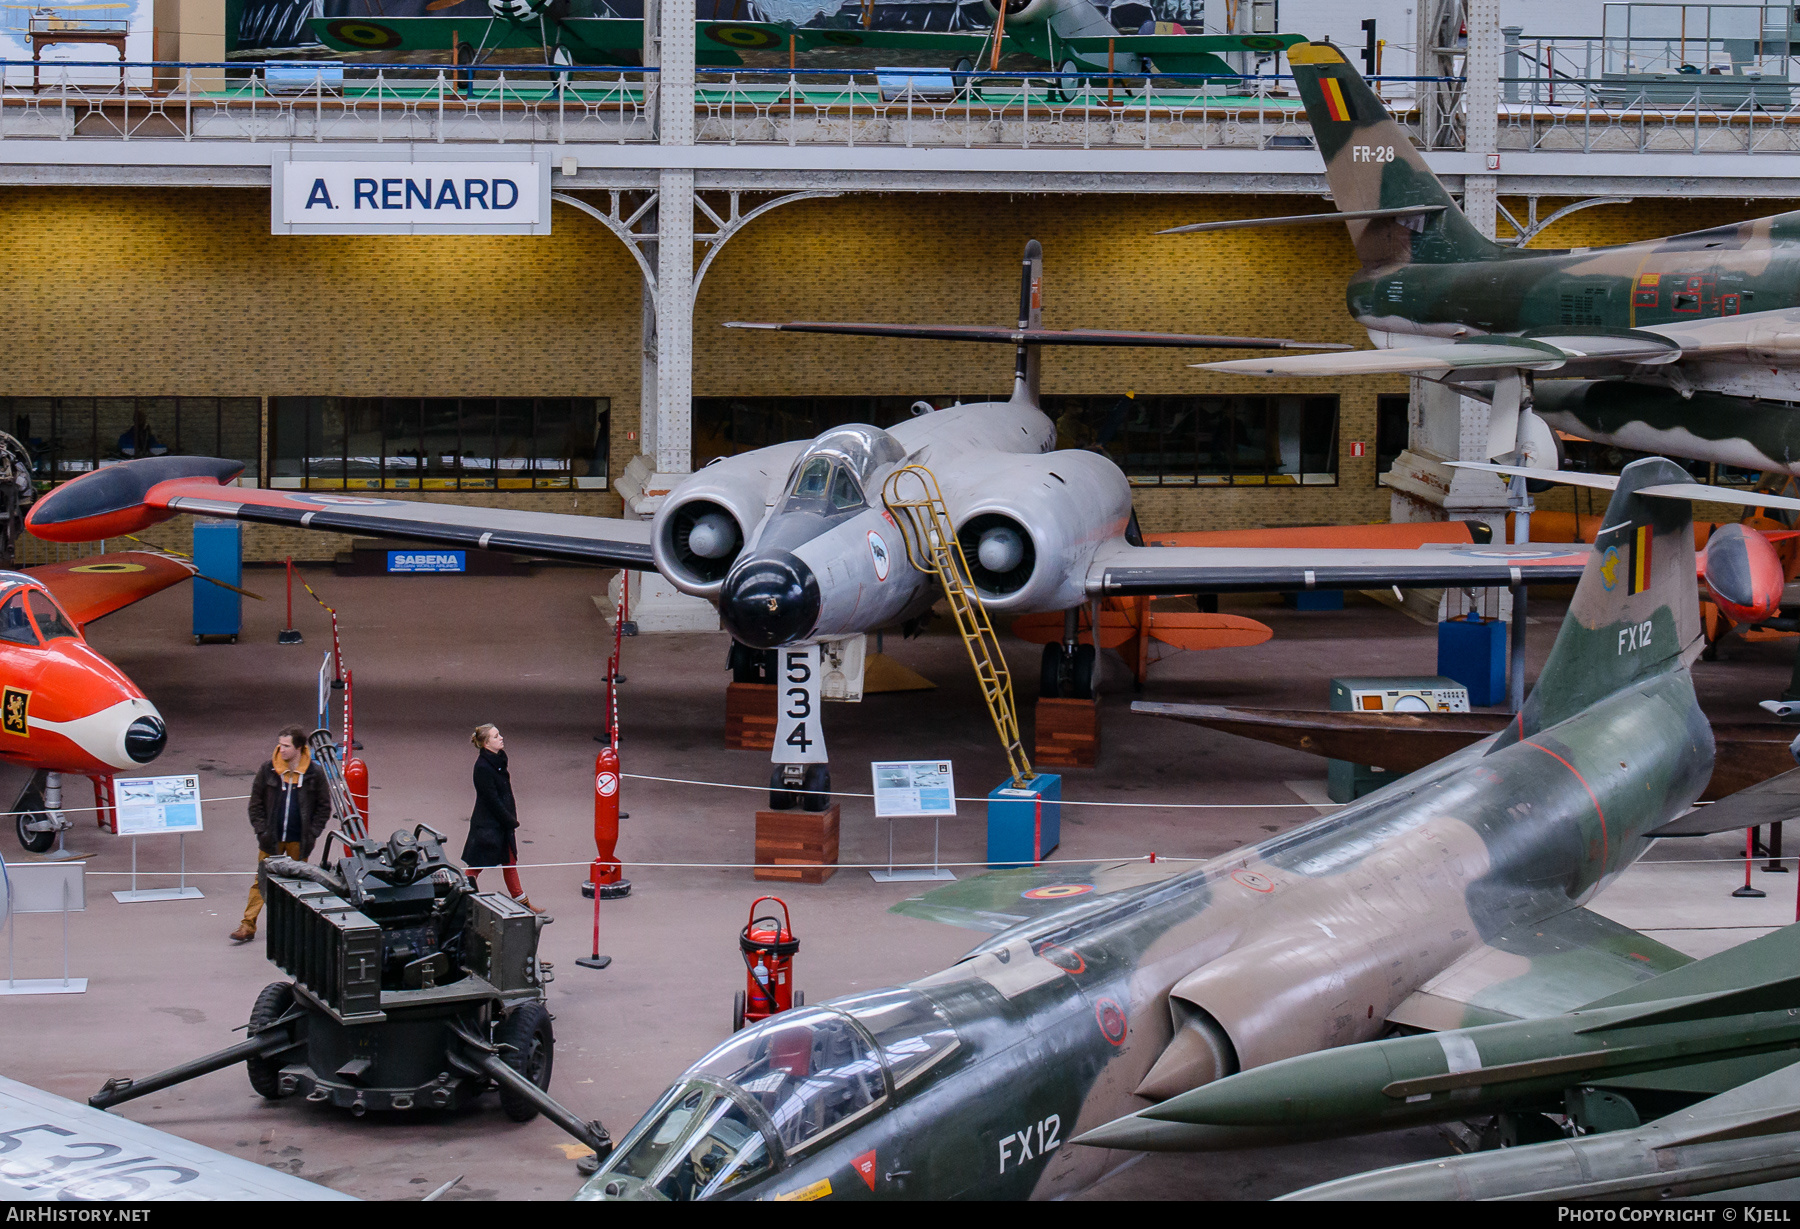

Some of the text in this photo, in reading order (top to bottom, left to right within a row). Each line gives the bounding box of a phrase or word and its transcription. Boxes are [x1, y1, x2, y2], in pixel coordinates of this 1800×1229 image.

[1352, 145, 1395, 164] FR-28
[305, 178, 519, 209] A. RENARD
[394, 555, 458, 564] SABENA
[1618, 620, 1653, 656] FX12
[786, 652, 813, 753] 534
[998, 1113, 1061, 1174] FX12
